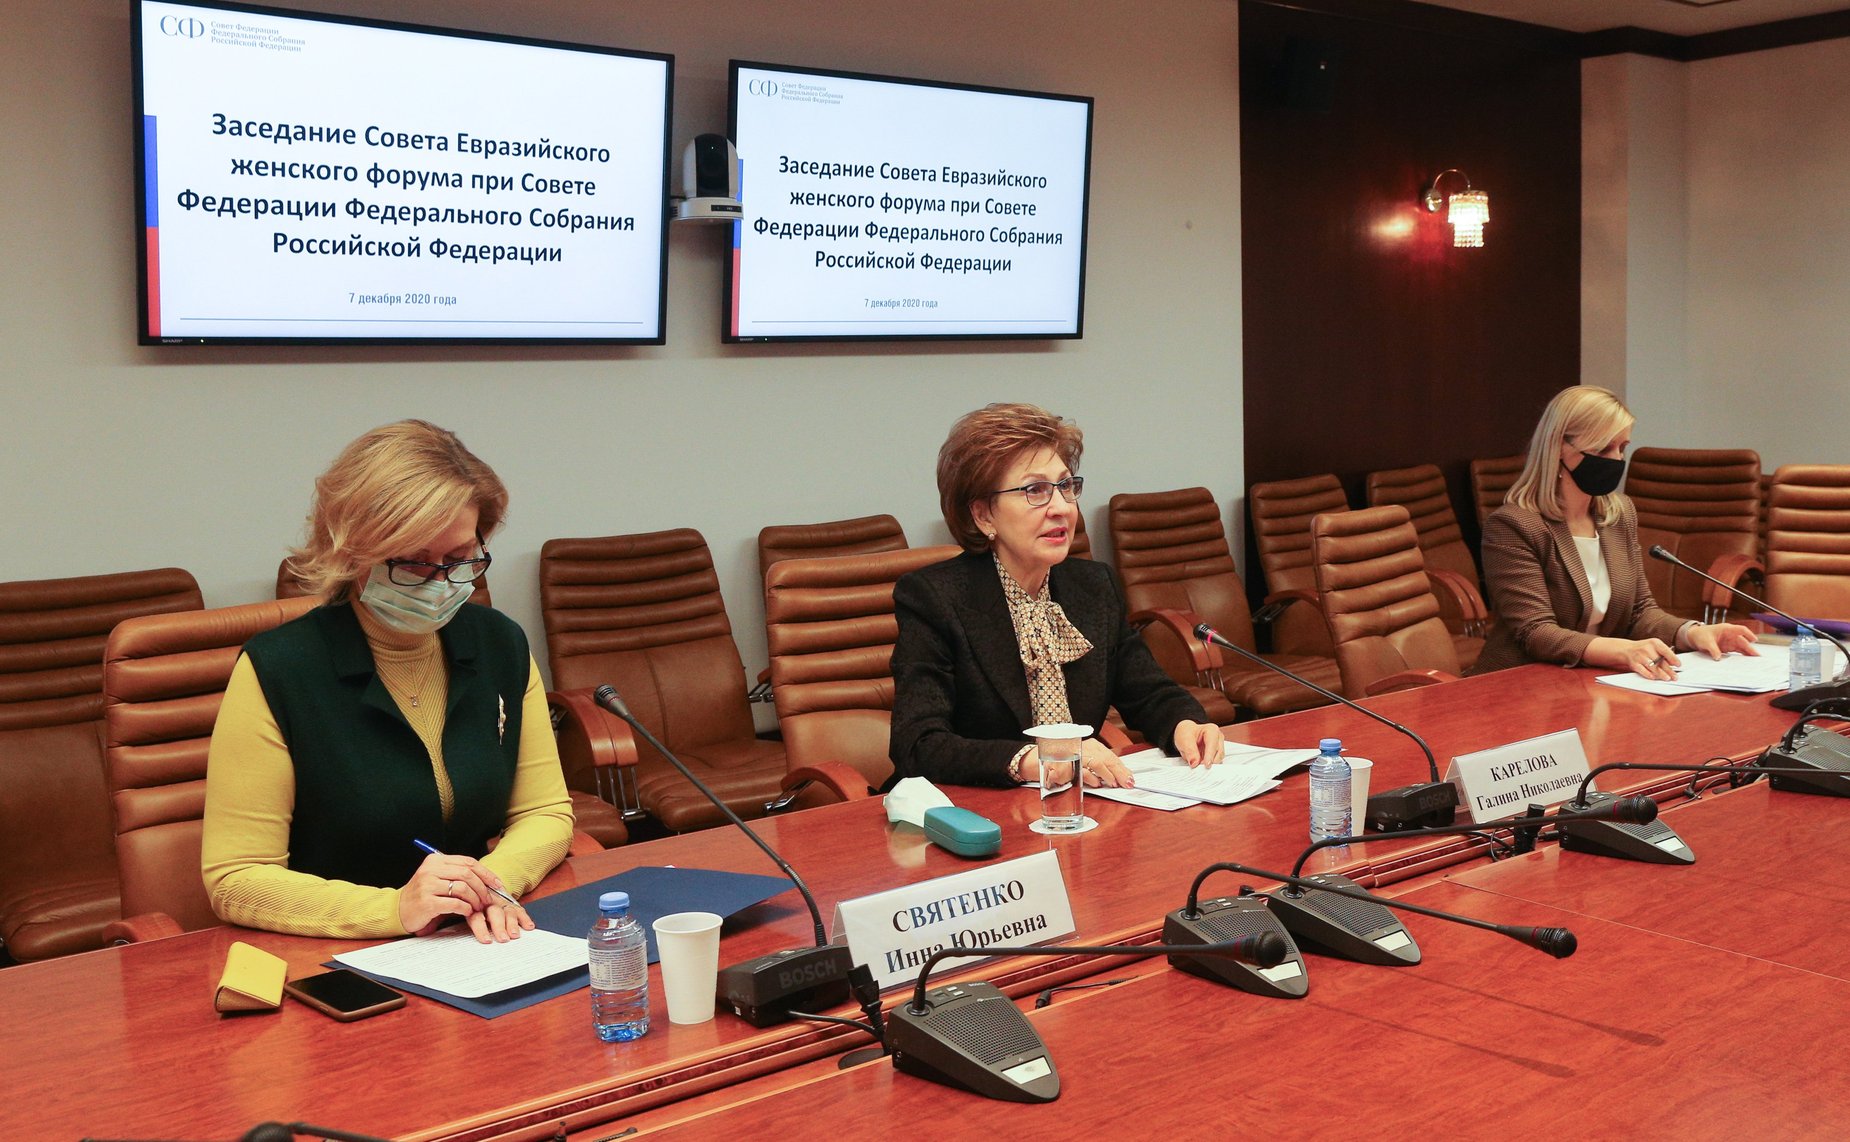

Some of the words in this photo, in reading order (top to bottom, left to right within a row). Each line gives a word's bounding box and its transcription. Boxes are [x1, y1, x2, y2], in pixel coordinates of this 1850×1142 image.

[160, 15, 205, 38] СФ
[210, 21, 233, 30] Совет
[235, 24, 279, 35] Федерации
[210, 28, 267, 41] Федерального
[268, 36, 306, 45] Собрания
[210, 36, 257, 48] Российской
[258, 42, 302, 52] Федерации
[748, 79, 778, 97] СФ
[212, 112, 357, 146] Заседание
[364, 125, 449, 152] Совета
[457, 132, 610, 163] Евразийского
[230, 158, 358, 182] женского
[366, 162, 463, 192] форума
[471, 174, 514, 195] при
[521, 172, 596, 196] Совете
[778, 155, 875, 180] Заседание
[879, 162, 937, 182] Совета
[942, 166, 1047, 189] Евразийского
[177, 188, 336, 222] Федерации
[345, 197, 522, 227] Федерального
[529, 207, 635, 234] Собрания
[789, 191, 875, 209] женского
[879, 191, 946, 215] форума
[950, 200, 980, 217] при
[984, 197, 1037, 216] Совете
[753, 216, 859, 241] Федерации
[864, 221, 985, 244] Федерального
[989, 226, 1063, 248] Собрания
[273, 232, 421, 258] Российской
[429, 237, 562, 266] Федерации
[815, 250, 915, 270] Российской
[920, 252, 1012, 275] Федерации
[349, 292, 355, 304] 7
[358, 293, 402, 306] декабря
[404, 293, 431, 305] 2020
[433, 296, 457, 306] года
[870, 299, 901, 310] декабря
[902, 298, 921, 308] 2020
[921, 300, 938, 309] года
[1489, 753, 1558, 782] КАРЕЛОВА
[1476, 790, 1520, 811] Галина
[1520, 772, 1584, 799] Николаевна
[892, 879, 1025, 933] СВЯТЕНКО
[949, 913, 1048, 949] Юрьевна
[779, 958, 838, 990] BOSCH
